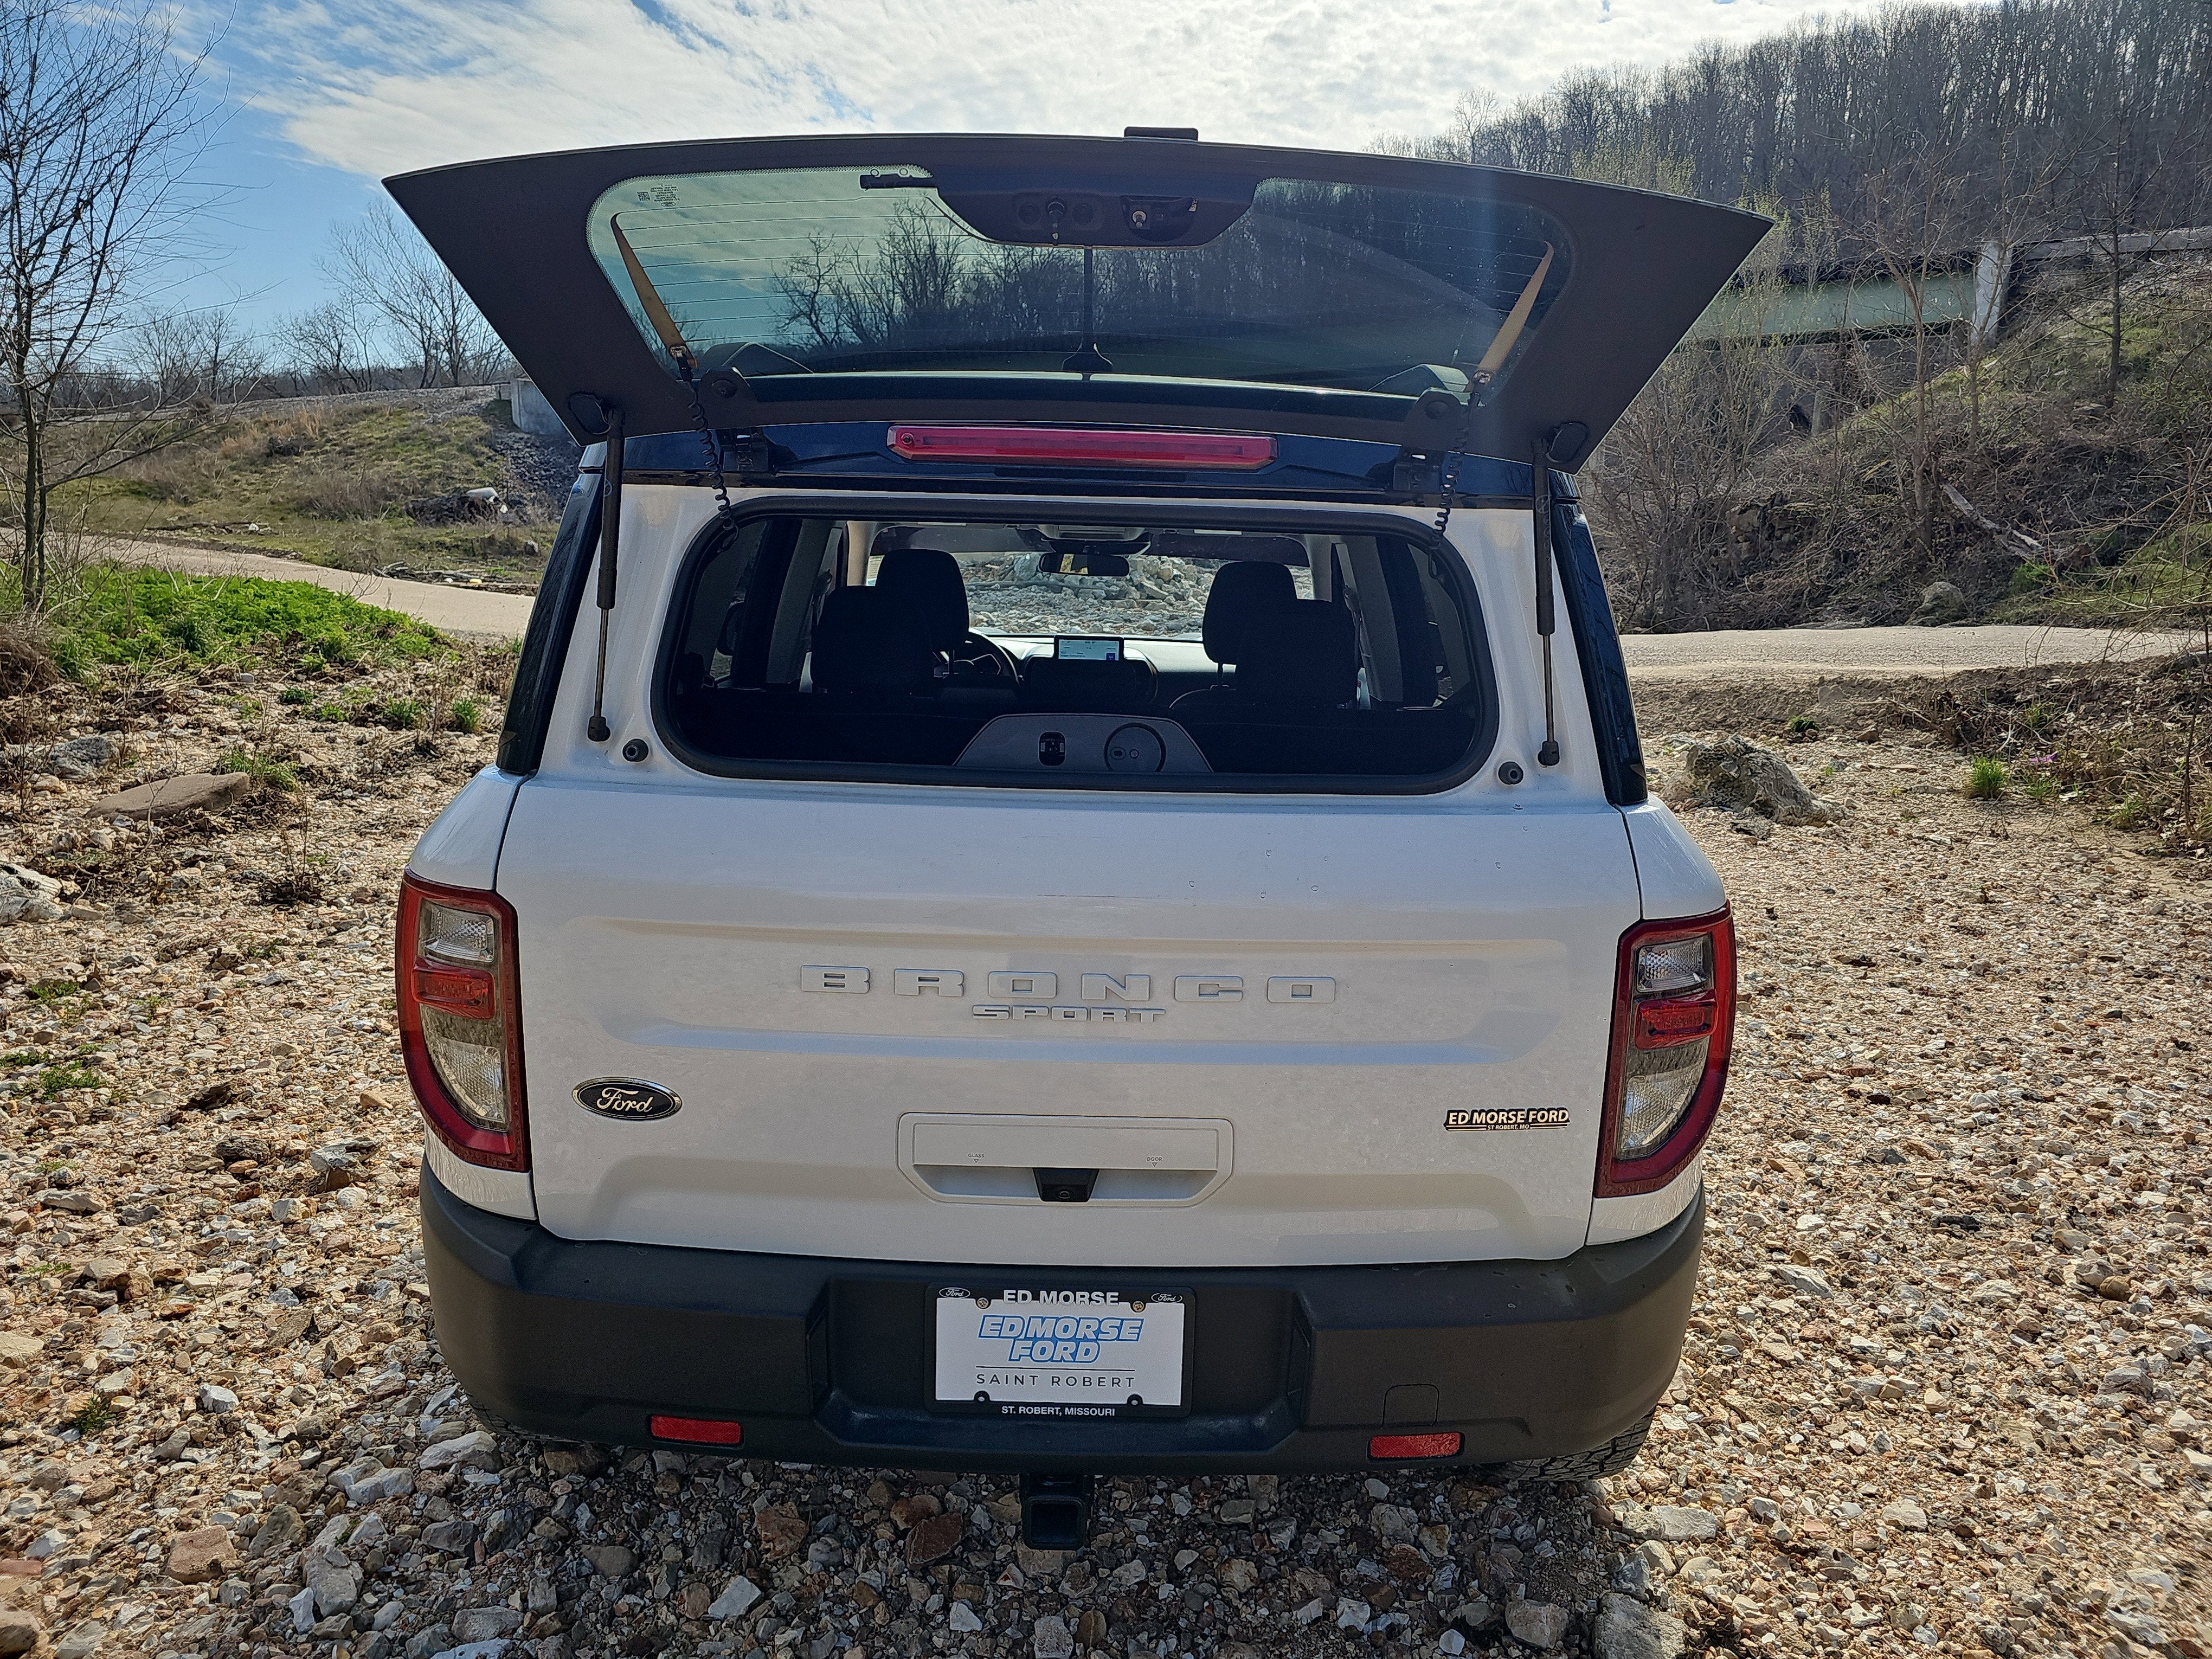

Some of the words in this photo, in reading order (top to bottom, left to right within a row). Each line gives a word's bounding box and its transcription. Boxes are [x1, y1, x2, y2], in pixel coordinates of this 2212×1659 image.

[800, 964, 1335, 1004] BRONCO
[972, 1004, 1165, 1023] SPORT
[596, 1087, 653, 1112] Ford
[1449, 1112, 1469, 1124] ED
[1472, 1111, 1525, 1124] MORSE
[1528, 1110, 1569, 1123] FORD
[1003, 1289, 1032, 1304] ED
[1039, 1291, 1119, 1306] MORSE
[978, 1315, 1025, 1338] ED
[1025, 1316, 1144, 1342] MORSE
[1008, 1340, 1100, 1363] FORD
[976, 1374, 1039, 1386] SAINT
[1051, 1376, 1135, 1387] ROBERT
[1001, 1406, 1016, 1414] ST.
[1019, 1406, 1062, 1416] ROBERT,
[1065, 1407, 1115, 1416] MISSOURI
